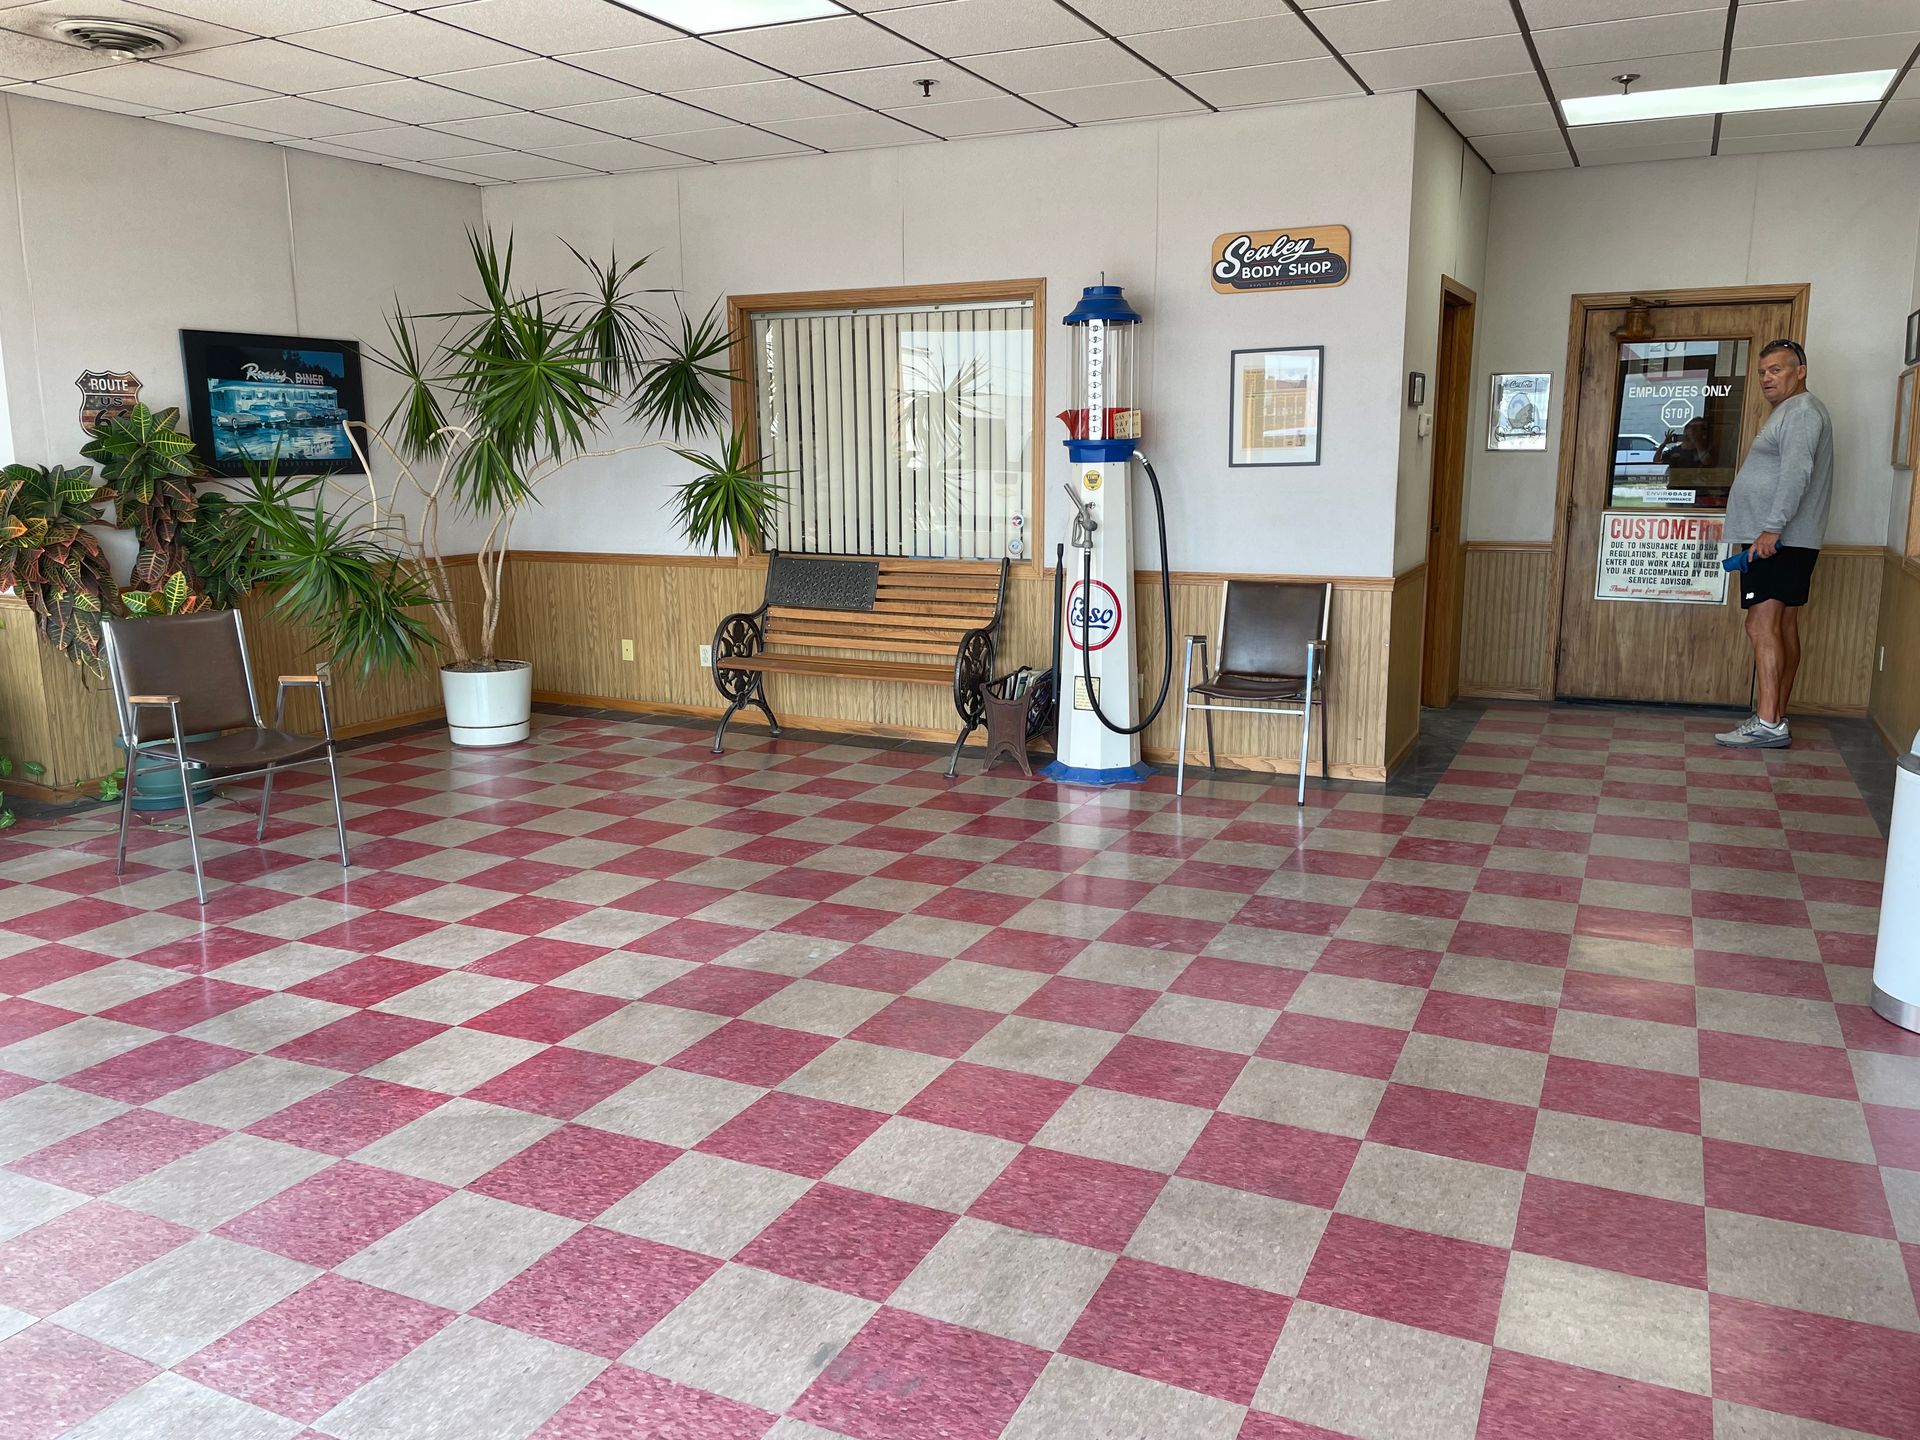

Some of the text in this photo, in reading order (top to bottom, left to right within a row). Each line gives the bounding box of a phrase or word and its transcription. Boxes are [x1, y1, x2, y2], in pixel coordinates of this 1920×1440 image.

[1215, 235, 1327, 278] Sealey
[1242, 261, 1332, 279] BODY SHOP
[90, 378, 129, 391] ROUTE
[295, 372, 324, 385] DINER
[1628, 384, 1733, 398] EMPLOYEES ONLY
[95, 409, 128, 427] 6
[1664, 407, 1691, 419] STOP
[1610, 541, 1719, 551] DUE TO INSURANCE AND OSHA
[1661, 551, 1688, 559] PLEASE
[1690, 552, 1701, 560] DO
[1703, 552, 1719, 560] NOT
[1605, 558, 1720, 569] ENTER OUR WORK AREA UNLESS
[1606, 566, 1719, 578] YOU ARE ACCOMPANIED BY OUR
[1628, 576, 1693, 586] SERVICE ADVISOR.
[1609, 584, 1629, 593] Thank
[1630, 588, 1643, 596] you
[1644, 587, 1656, 595] for
[1656, 589, 1673, 597] your
[1070, 596, 1114, 629] Esso
